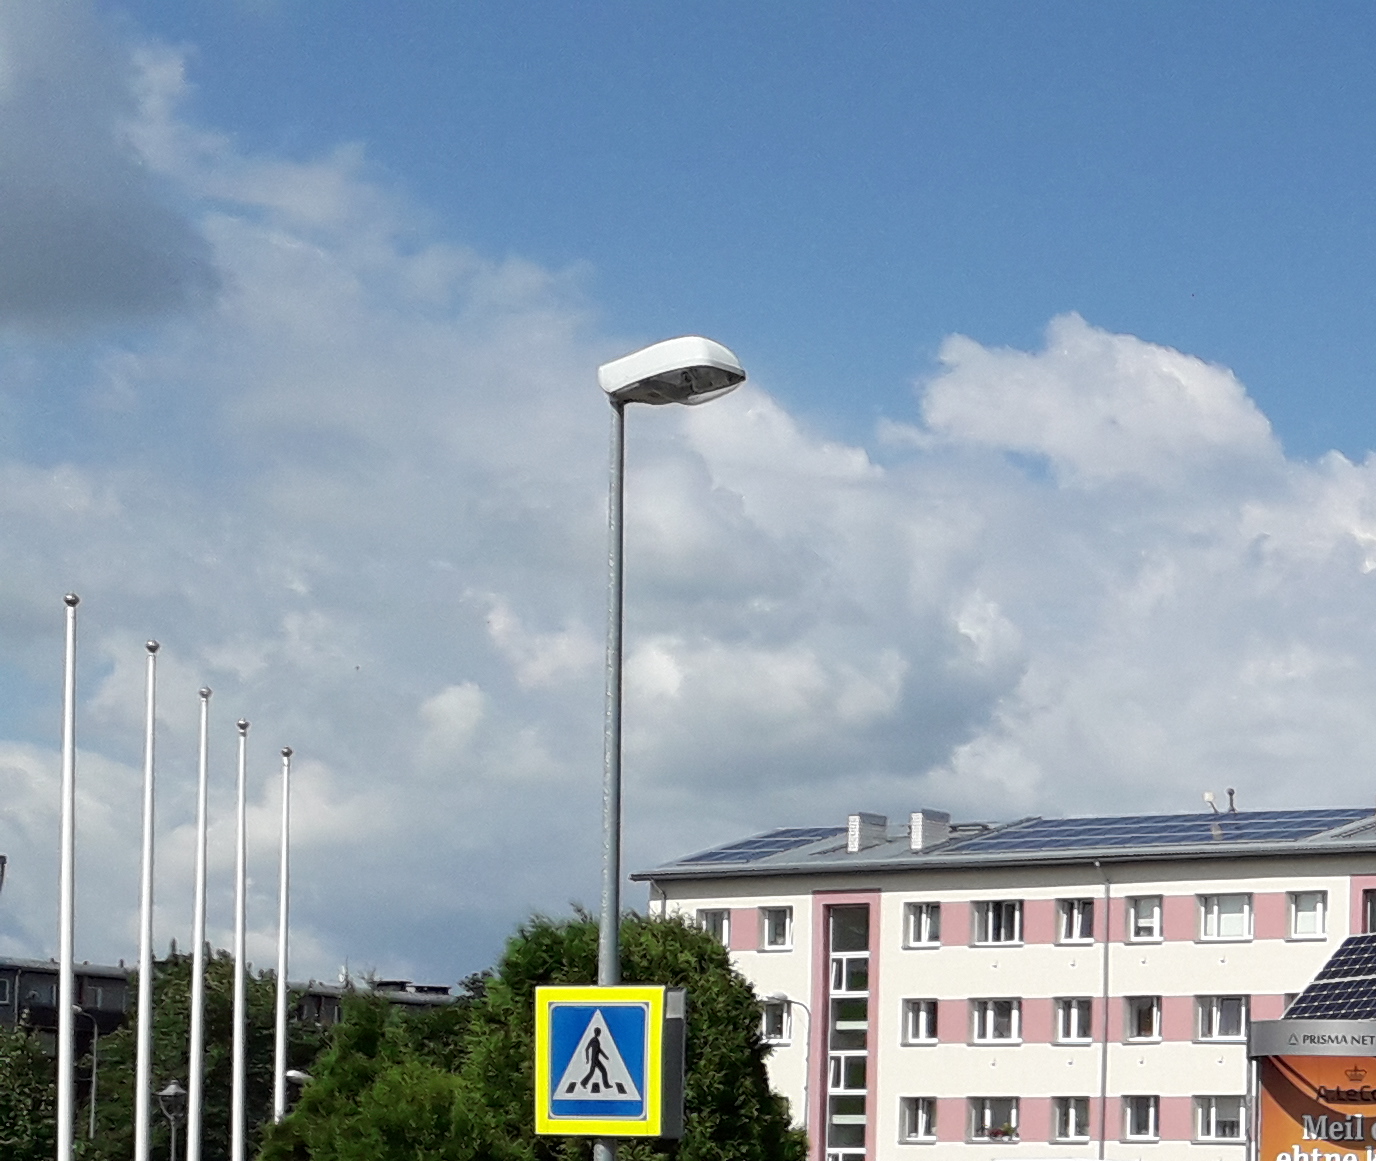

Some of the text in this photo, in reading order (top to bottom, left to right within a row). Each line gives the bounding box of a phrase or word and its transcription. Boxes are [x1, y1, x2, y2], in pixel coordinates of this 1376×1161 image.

[1302, 1034, 1376, 1045] PRISMA NET
[1301, 1113, 1364, 1140] Meil
